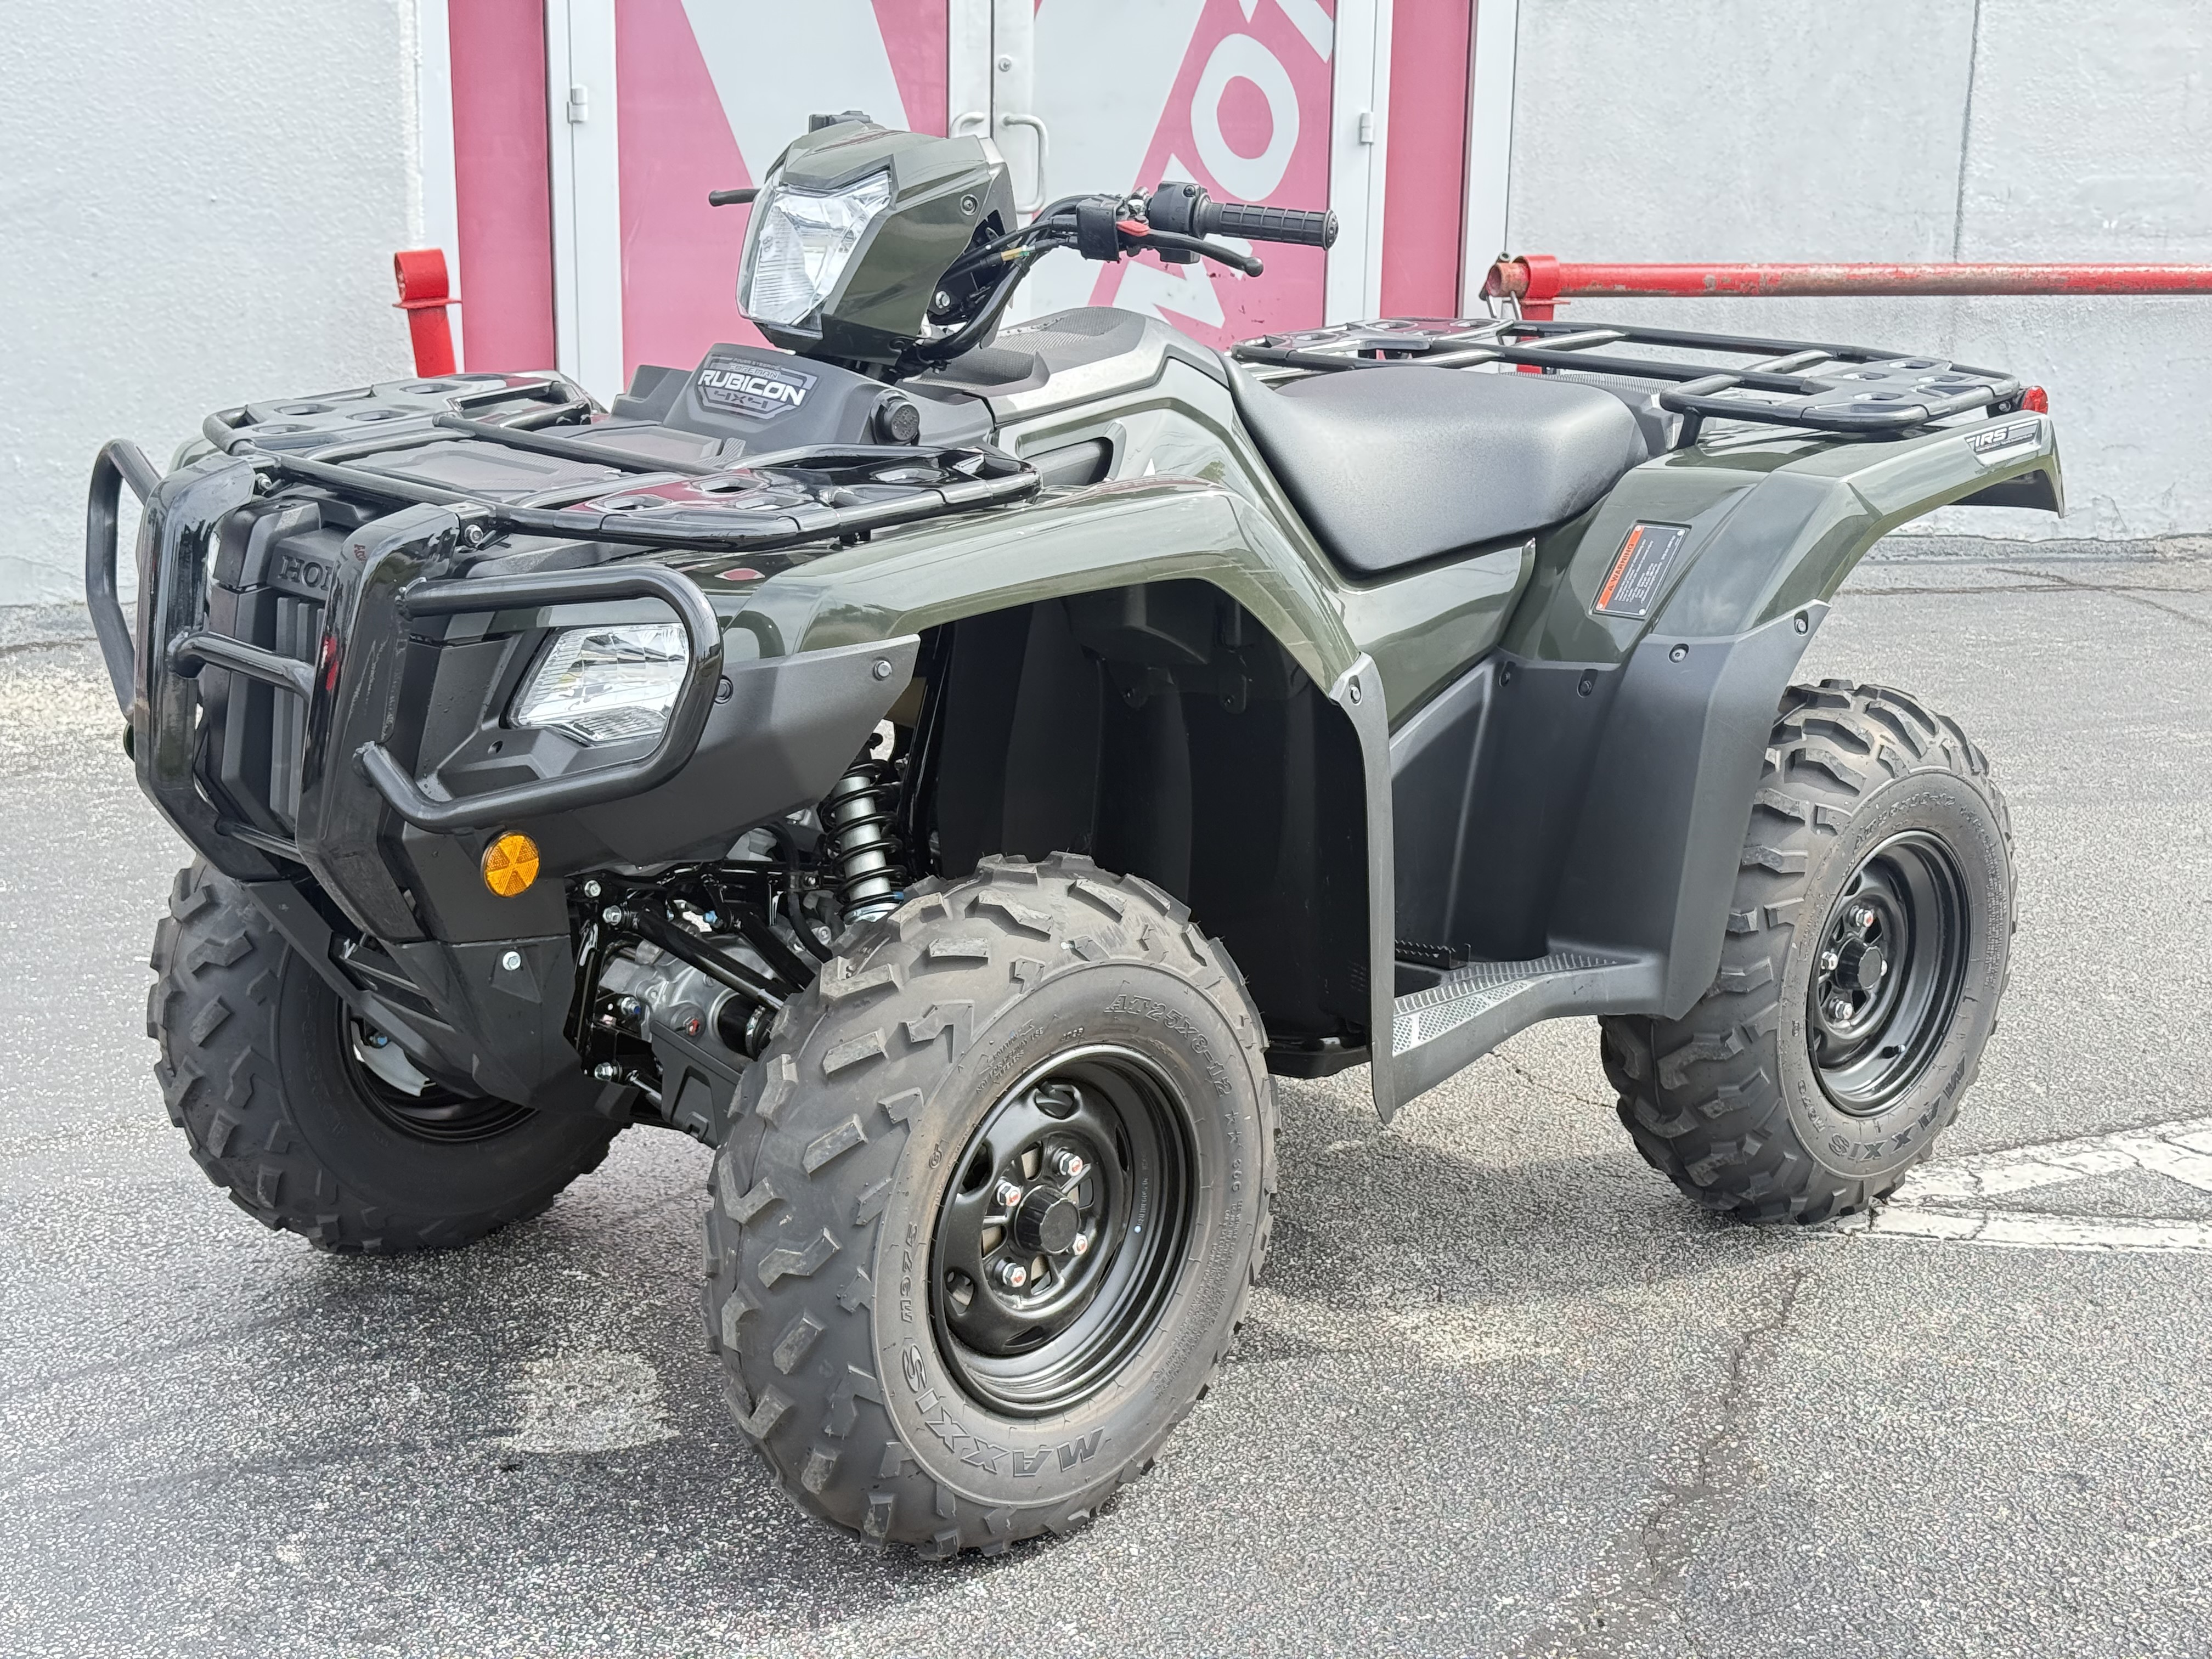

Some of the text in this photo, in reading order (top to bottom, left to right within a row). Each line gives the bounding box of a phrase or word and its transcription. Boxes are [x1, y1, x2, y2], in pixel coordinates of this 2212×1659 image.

[697, 370, 806, 406] RUBICON
[727, 364, 780, 379] FOREMAN
[713, 390, 768, 409] 4X4
[1975, 427, 2007, 448] IRS
[1611, 543, 1634, 583] WARNING
[1828, 1055, 1966, 1163] MAXXIS
[900, 1221, 1105, 1477] MAXXIS M975
